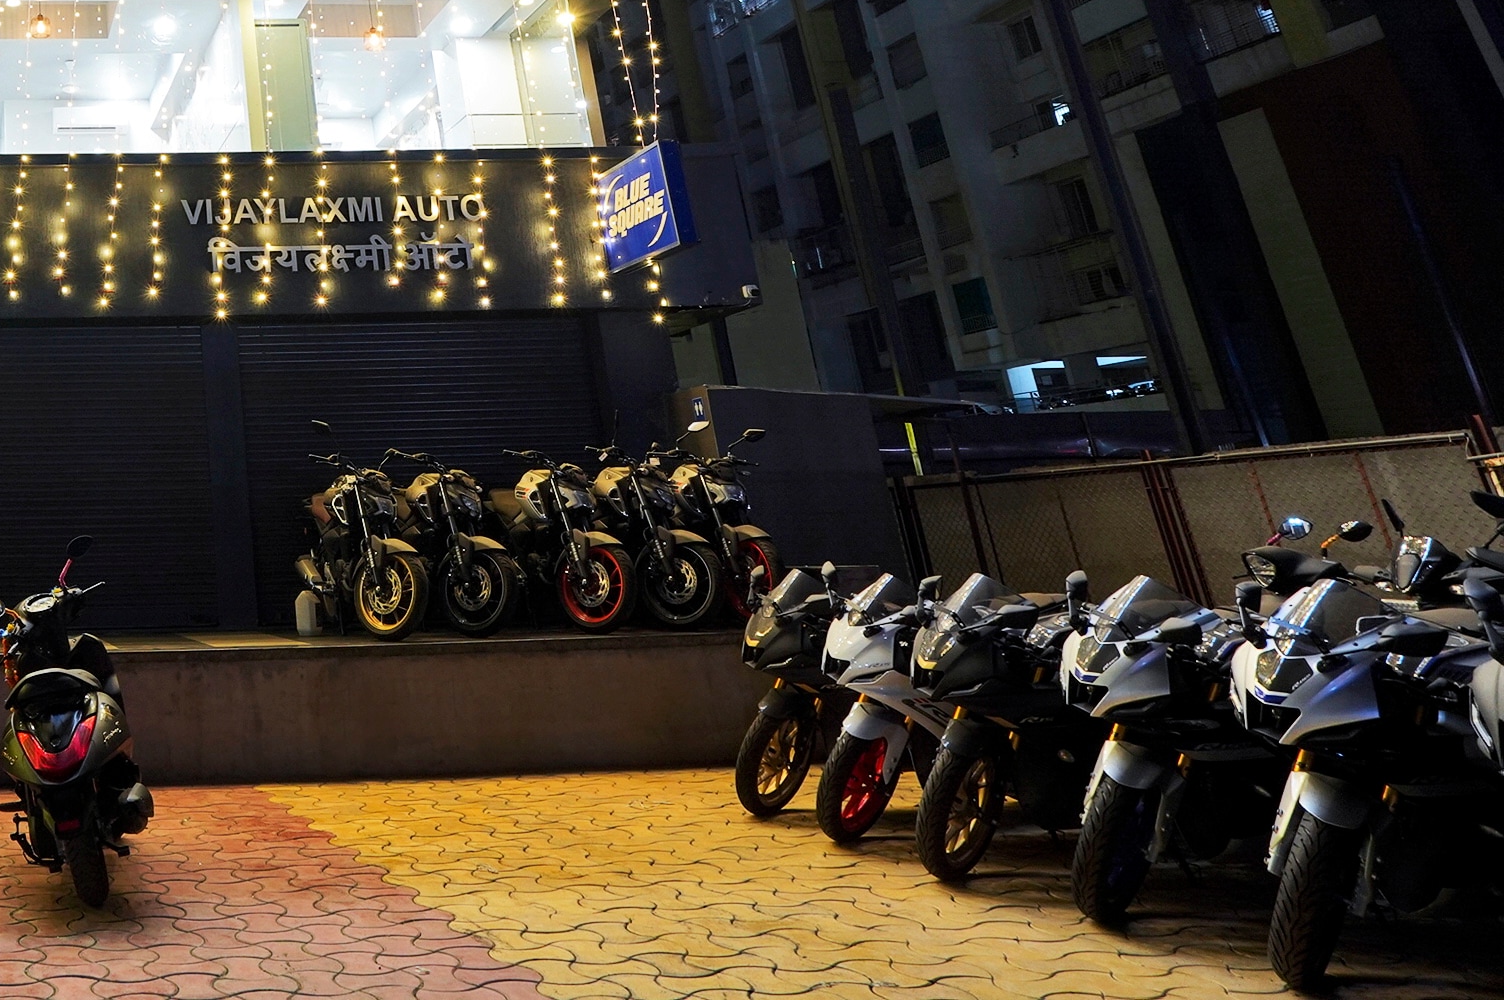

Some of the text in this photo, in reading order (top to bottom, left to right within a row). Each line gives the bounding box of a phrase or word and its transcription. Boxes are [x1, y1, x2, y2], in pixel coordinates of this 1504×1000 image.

[180, 194, 484, 226] VIJAYLAXMI AUTO
[614, 171, 651, 212] BLUE
[608, 189, 665, 238] SQUARE
